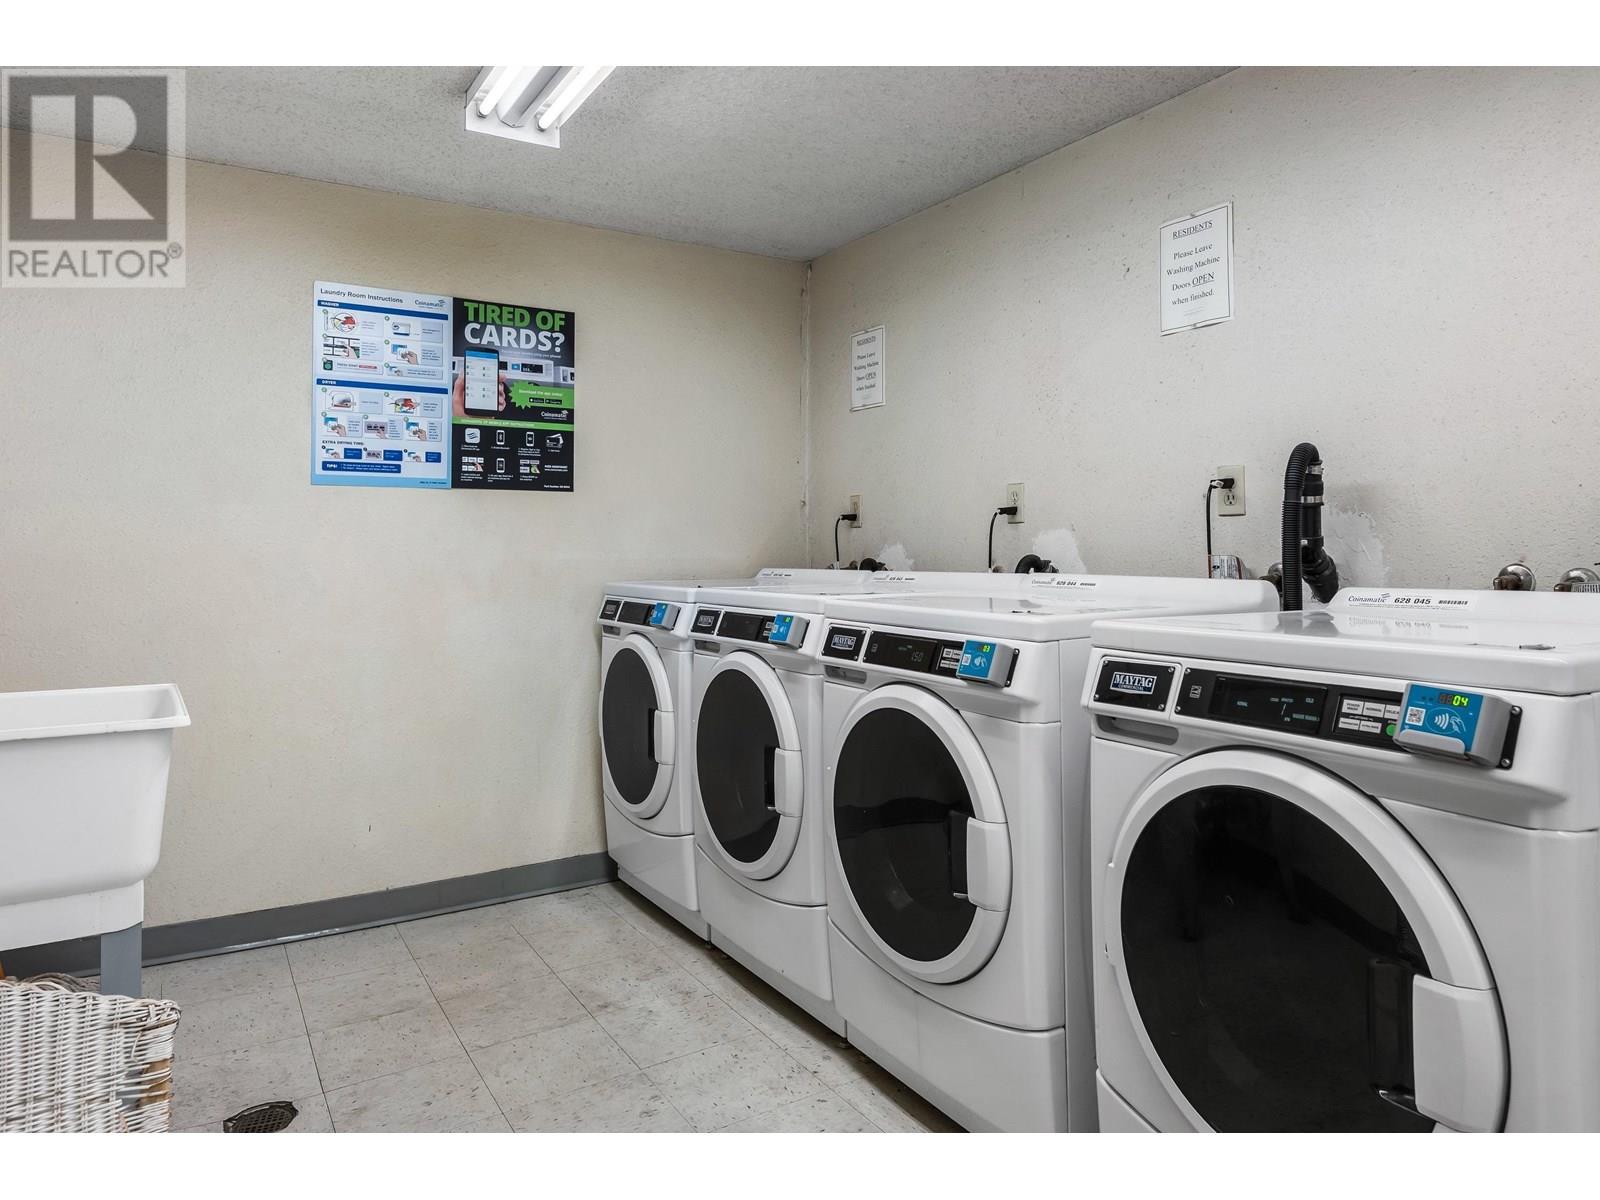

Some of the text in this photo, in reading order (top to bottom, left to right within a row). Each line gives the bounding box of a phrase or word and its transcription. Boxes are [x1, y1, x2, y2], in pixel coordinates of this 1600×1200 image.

[1172, 220, 1213, 240] RESIDENTS
[1173, 243, 1213, 261] Please Leave
[1166, 256, 1220, 276] Washing Machine
[1172, 271, 1215, 291] Doors OPEN
[320, 287, 403, 304] Laundry Room Instructions
[1171, 294, 1189, 306] when
[463, 301, 566, 332] TIRED OF
[464, 322, 566, 353] CARDS?
[1348, 595, 1386, 604] Coinamatic
[1394, 597, 1411, 605] 628
[1114, 674, 1153, 688] MAYTAG
[1452, 695, 1469, 706] 04
